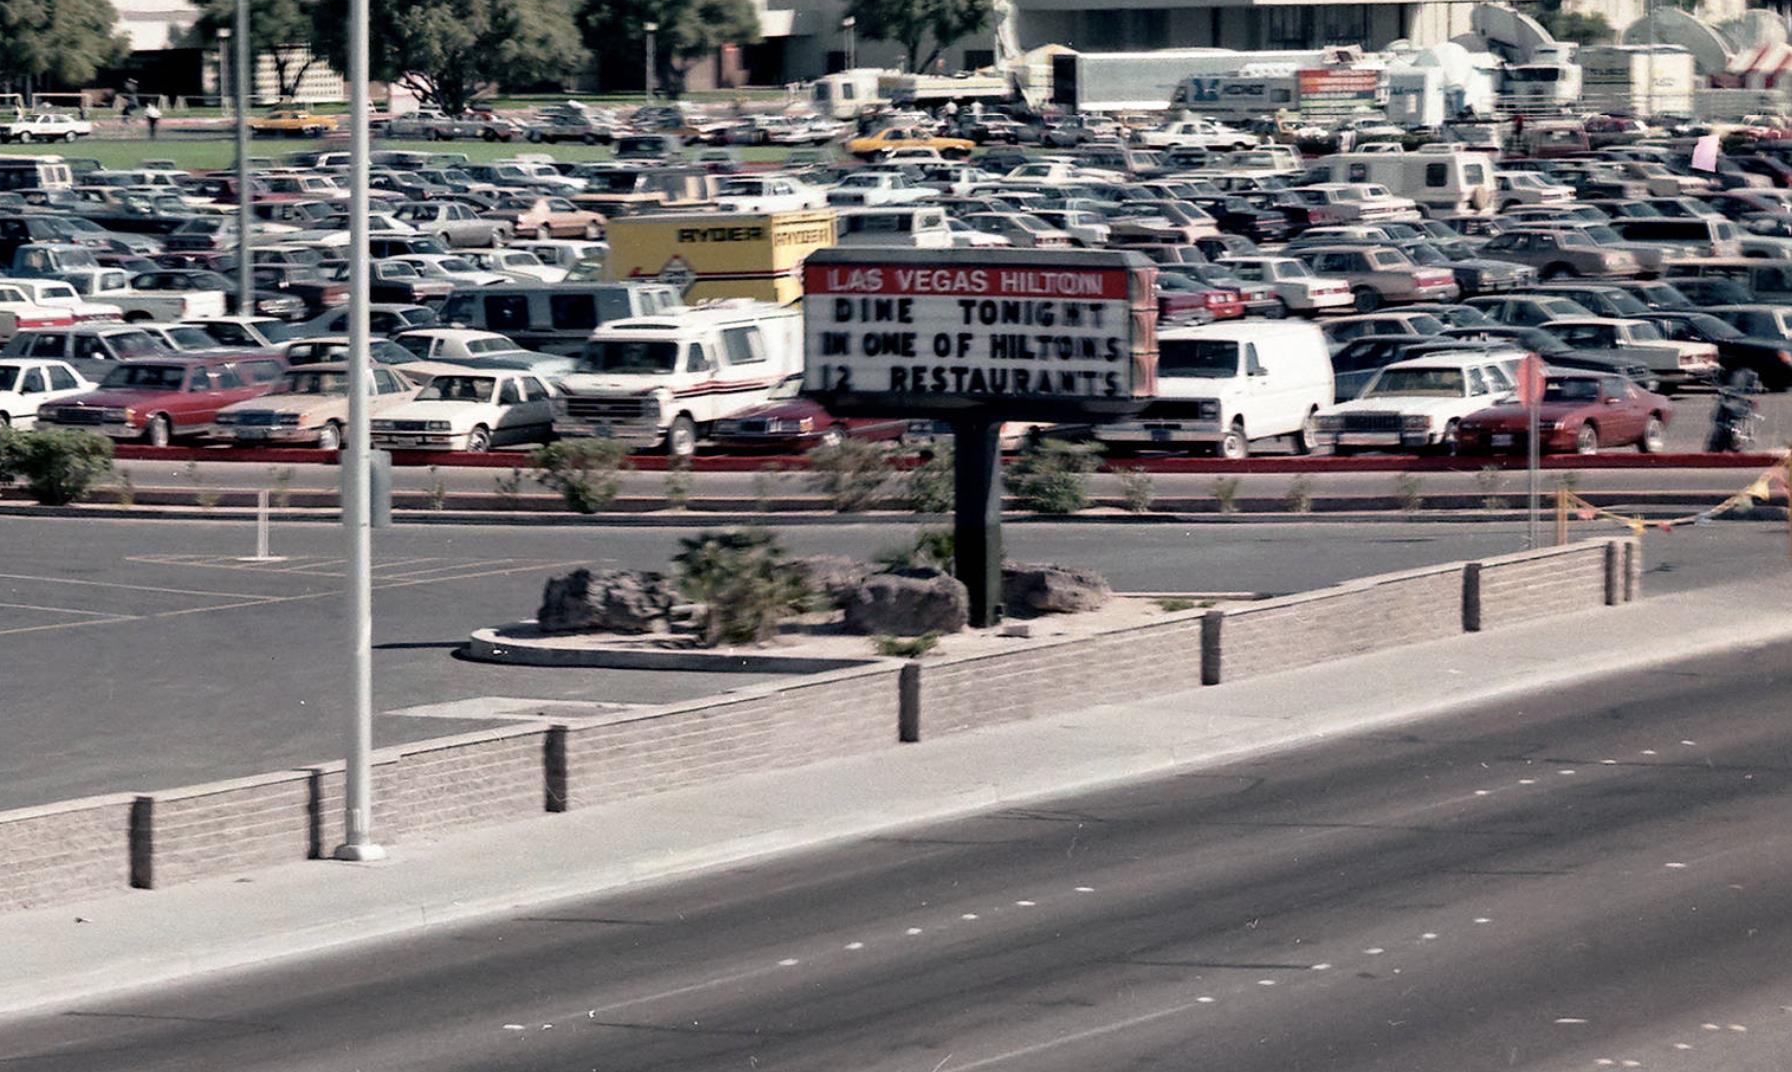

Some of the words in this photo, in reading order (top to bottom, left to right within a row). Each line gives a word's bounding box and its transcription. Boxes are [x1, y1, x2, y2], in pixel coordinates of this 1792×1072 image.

[678, 227, 762, 243] RYDER
[774, 228, 830, 247] RYDER
[827, 268, 884, 292] LAS
[894, 269, 989, 293] VEGAS
[1001, 270, 1104, 295] HILTON
[835, 298, 914, 325] DINE
[958, 299, 1106, 329] TONIGHT
[821, 331, 849, 357] IN
[862, 332, 918, 358] ONE
[933, 332, 974, 359] OF
[990, 333, 1122, 363] HILTONS
[821, 364, 853, 392] 12
[890, 366, 1121, 397] RESTAURANTS
